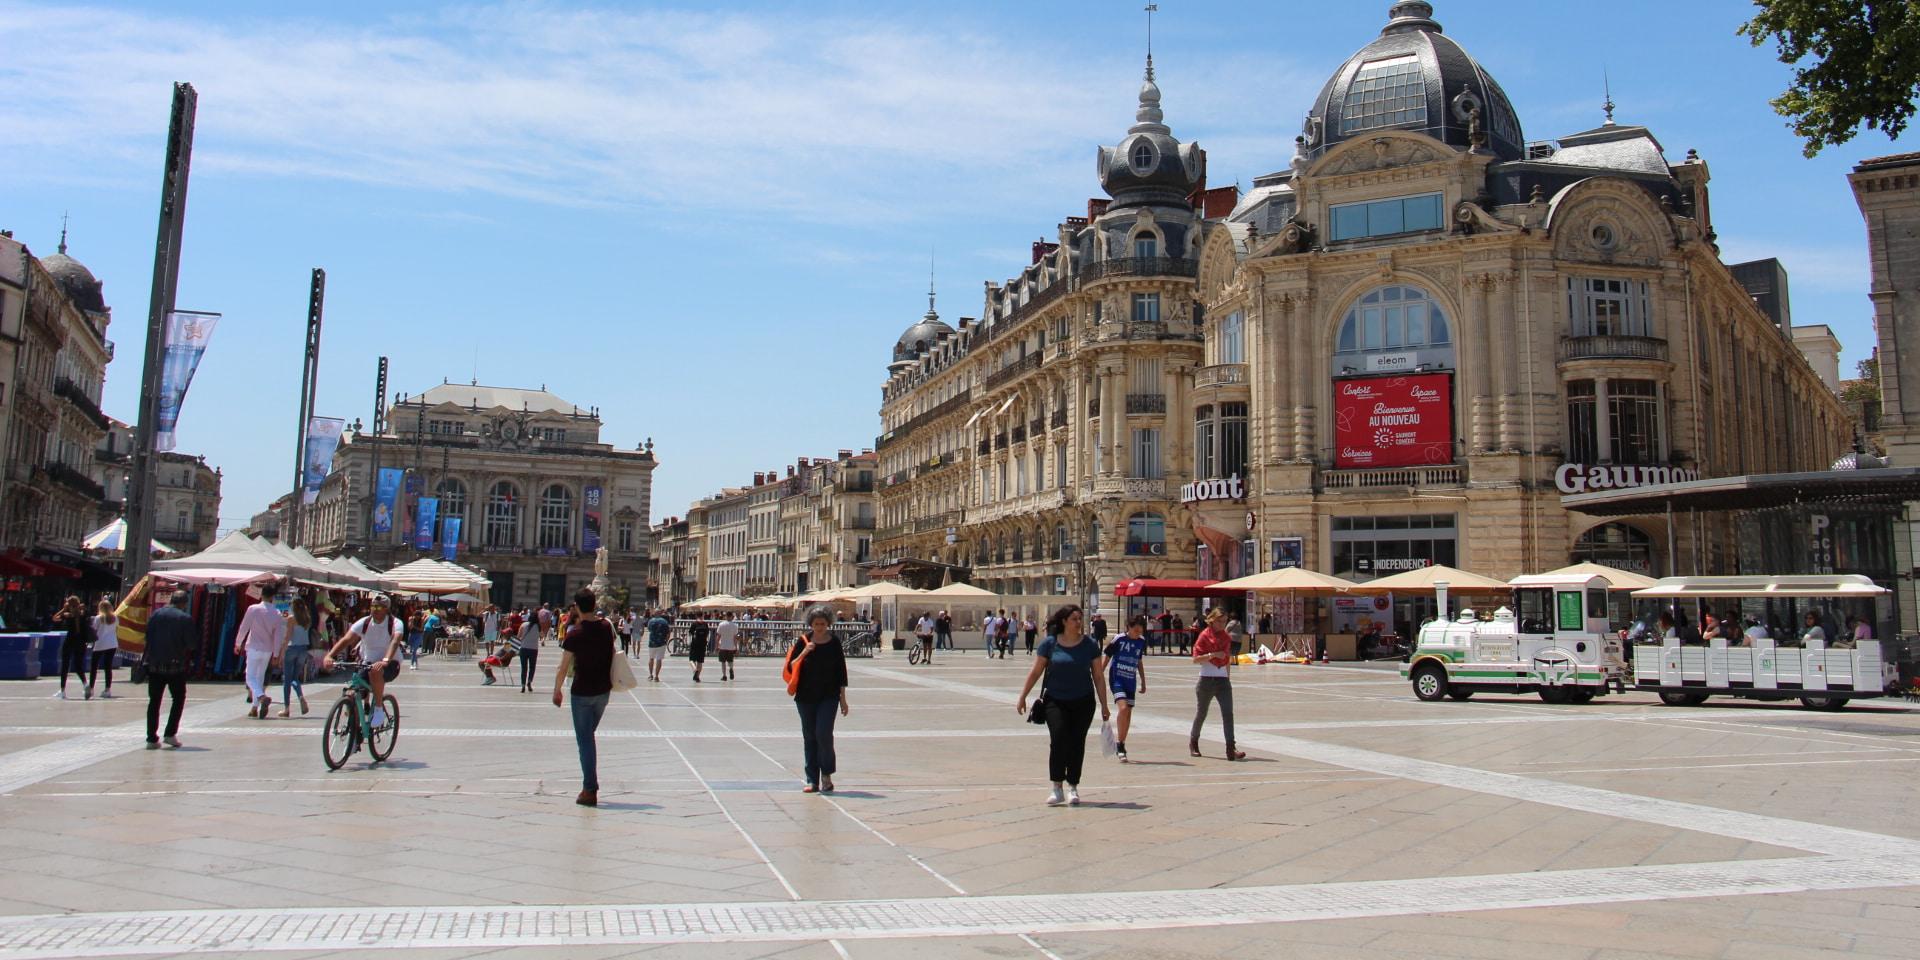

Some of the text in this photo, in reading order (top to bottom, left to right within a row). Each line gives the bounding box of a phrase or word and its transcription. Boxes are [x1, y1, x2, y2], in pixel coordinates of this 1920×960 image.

[1410, 385, 1437, 398] Espace
[1373, 402, 1416, 415] Bienvenue
[1369, 413, 1420, 427] AU NOUVEAU
[1341, 446, 1373, 458] Services
[587, 489, 599, 498] 18
[587, 498, 599, 506] 19
[1374, 559, 1426, 570] INDEPENDENCE
[1120, 641, 1130, 652] 74
